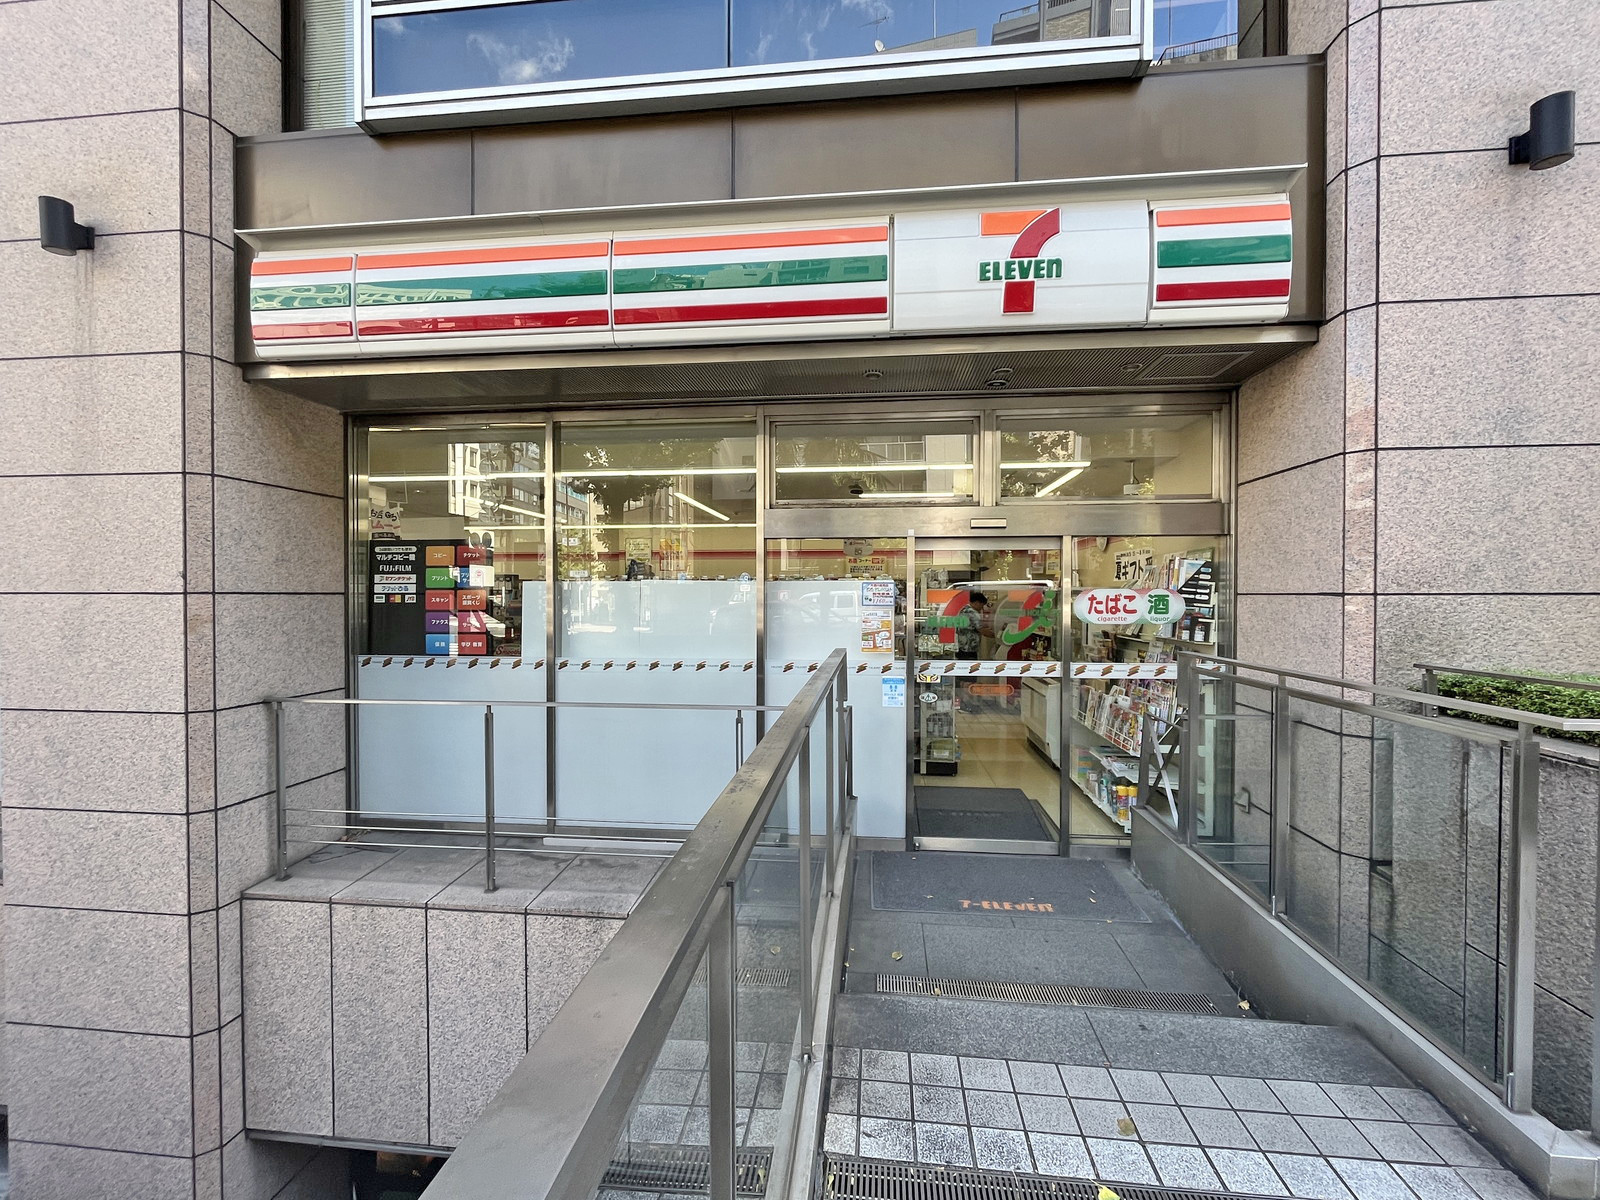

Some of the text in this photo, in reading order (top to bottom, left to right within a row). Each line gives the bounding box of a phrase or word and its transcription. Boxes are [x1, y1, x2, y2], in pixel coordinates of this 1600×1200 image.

[980, 207, 1061, 314] 7
[1087, 593, 1138, 615] たばこ
[1147, 594, 1170, 615] 酒
